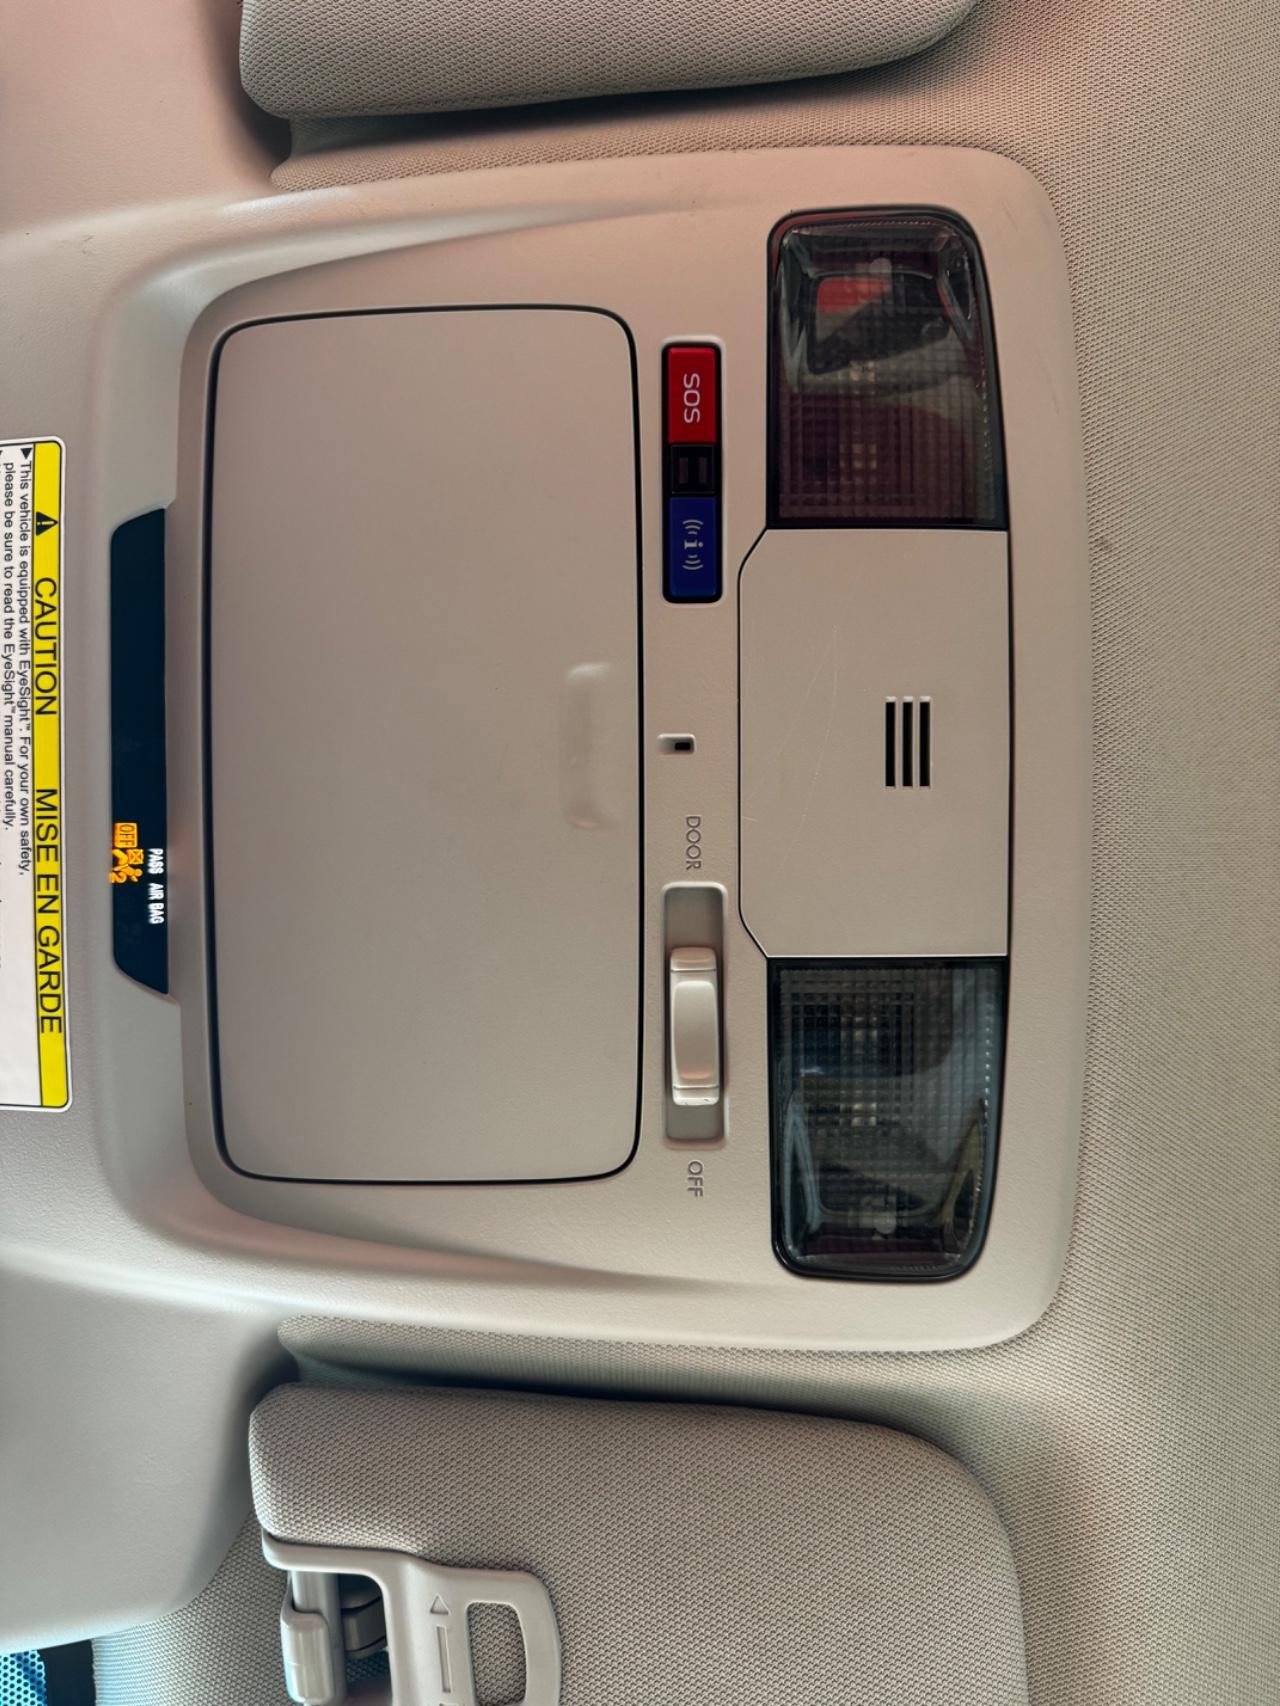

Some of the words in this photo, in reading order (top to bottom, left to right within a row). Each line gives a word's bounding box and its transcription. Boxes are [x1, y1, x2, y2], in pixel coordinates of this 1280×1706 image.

[683, 373, 701, 423] SOS
[2, 462, 15, 507] please
[20, 461, 32, 489] This
[4, 511, 15, 528] be
[20, 493, 31, 541] vehicle
[4, 532, 14, 560] sure
[20, 546, 31, 557] is
[4, 566, 15, 579] to
[4, 583, 16, 614] read
[17, 561, 30, 624] equipped
[4, 617, 15, 639] the
[19, 627, 31, 655] with
[35, 577, 57, 715] CAUTION
[4, 715, 16, 765] manual
[19, 736, 31, 759] For
[17, 764, 30, 794] your
[2, 769, 17, 831] carefully.
[20, 798, 30, 826] own
[36, 788, 59, 862] MISE
[119, 824, 136, 846] OFF
[18, 830, 32, 875] safety,
[686, 816, 702, 870] DOOR
[148, 848, 164, 875] PASS
[37, 874, 60, 913] EN
[148, 883, 164, 901] AIR
[148, 902, 165, 924] BAG
[38, 925, 62, 1034] GARDE
[687, 1160, 704, 1197] OFF
